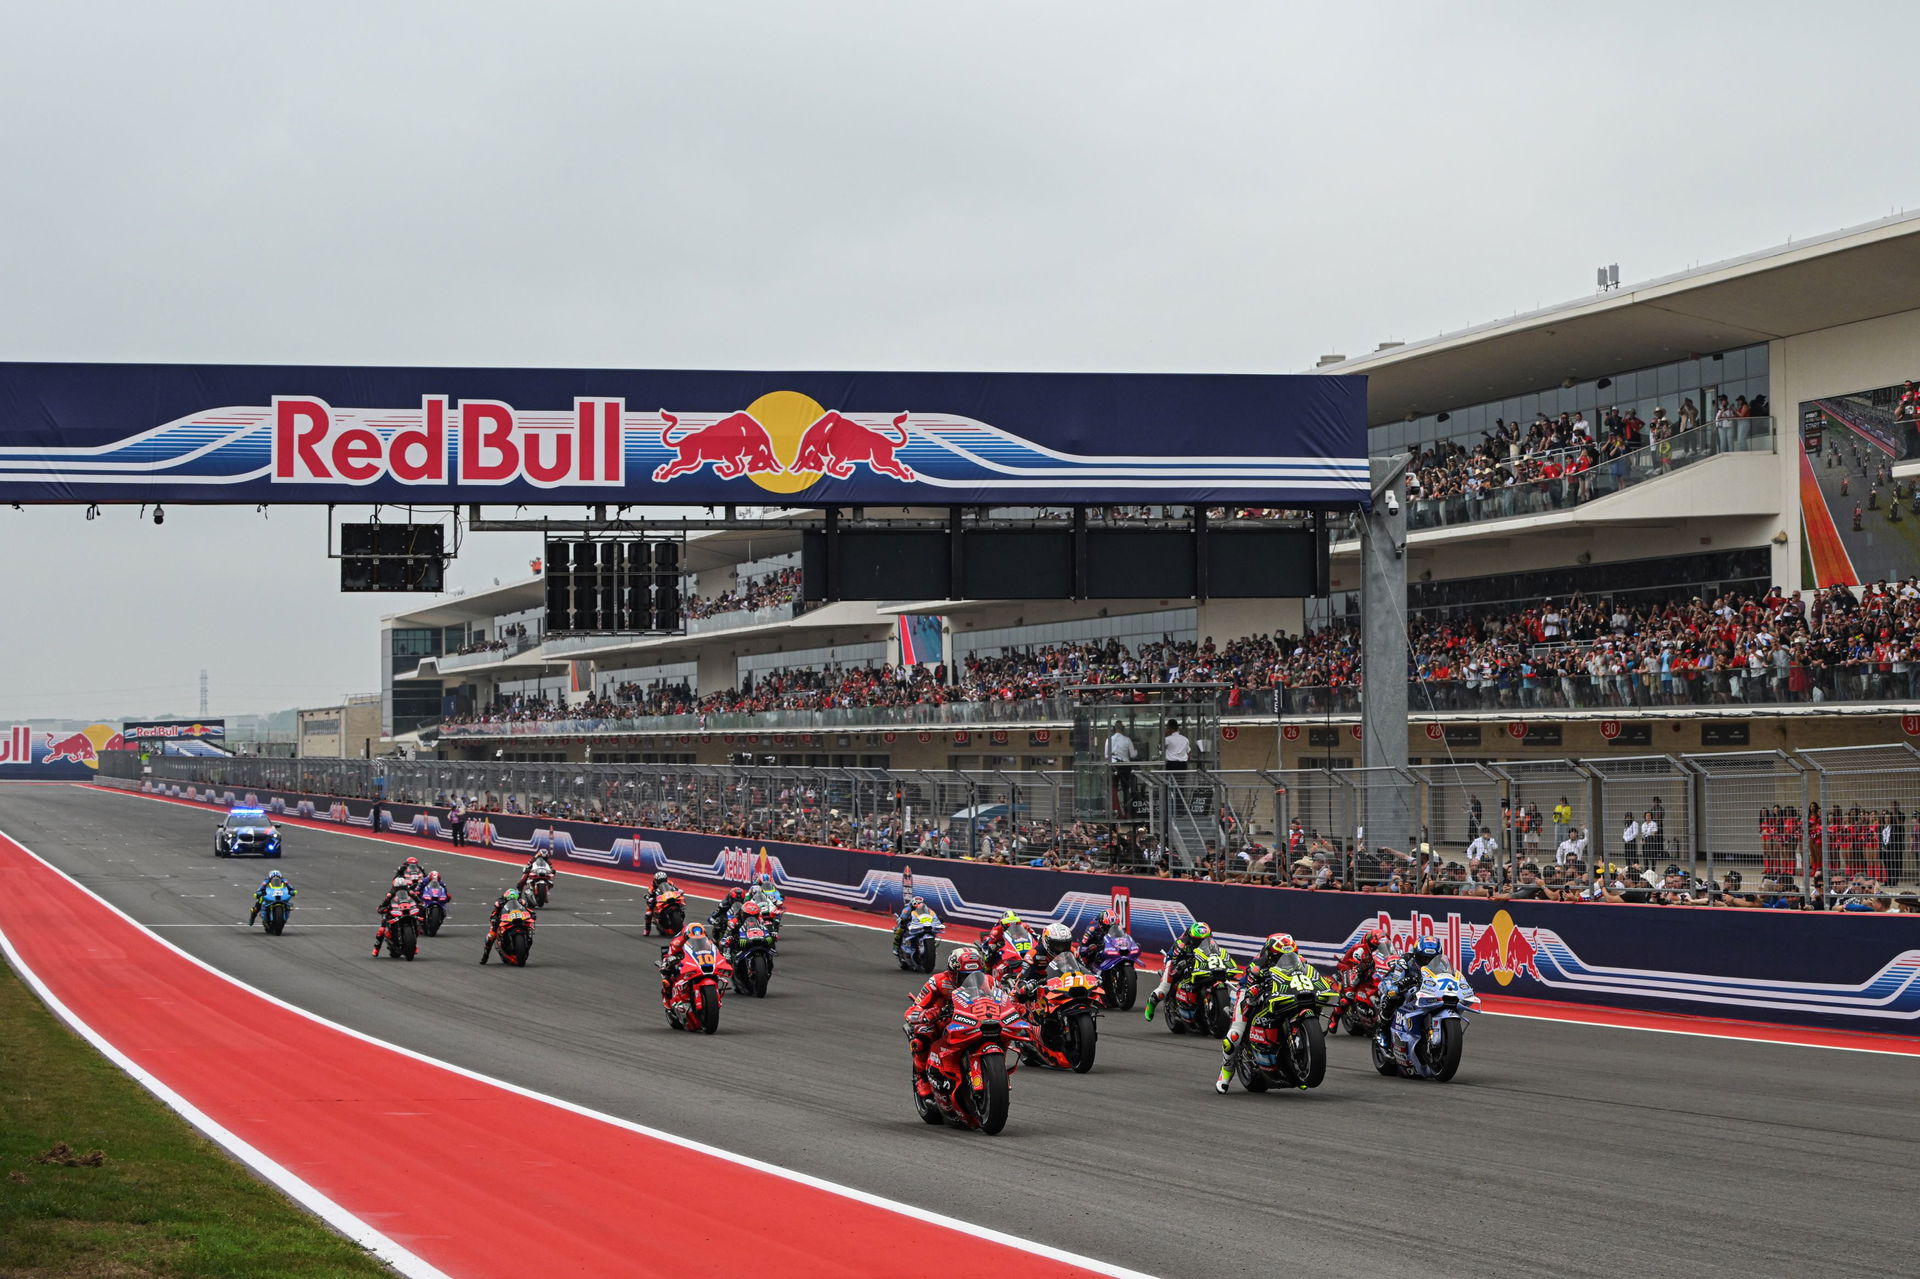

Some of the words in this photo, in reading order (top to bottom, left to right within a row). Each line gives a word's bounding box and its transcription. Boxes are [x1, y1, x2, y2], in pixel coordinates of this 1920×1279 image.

[1512, 724, 1523, 735] 29
[1605, 723, 1616, 735] 30
[1907, 716, 1919, 731] 31
[1225, 728, 1235, 737] 25
[1287, 727, 1297, 737] 26
[1430, 725, 1440, 736] 28
[1015, 941, 1032, 952] 36
[696, 954, 715, 966] 10
[1207, 954, 1226, 970] 21
[1064, 975, 1084, 988] 37
[1290, 974, 1315, 991] 49
[1437, 978, 1459, 991] 73
[971, 1002, 1000, 1017] 93
[954, 1014, 977, 1026] Lenovo
